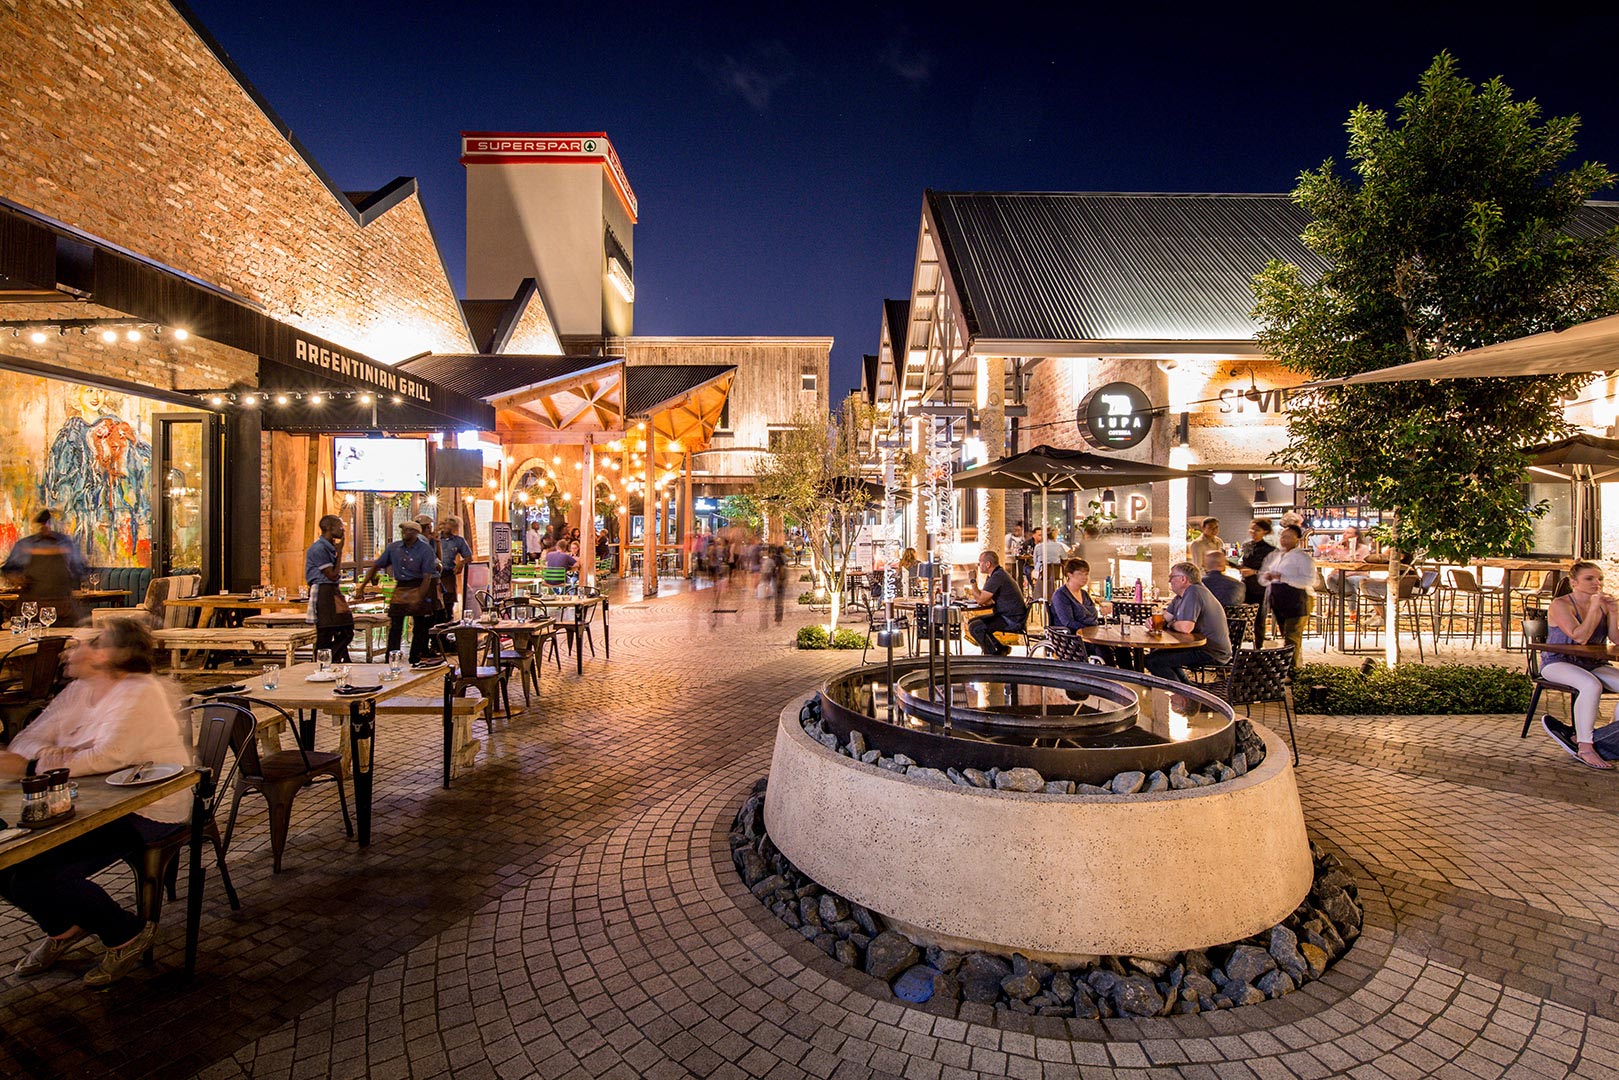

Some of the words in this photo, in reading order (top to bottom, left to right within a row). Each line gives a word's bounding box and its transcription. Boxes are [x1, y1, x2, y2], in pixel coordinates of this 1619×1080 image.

[477, 141, 581, 151] SUPERSPAR
[295, 338, 396, 391] ARGENTINIAN
[399, 377, 431, 403] GRILL
[1219, 388, 1244, 413] SI
[1098, 417, 1141, 428] LUPA
